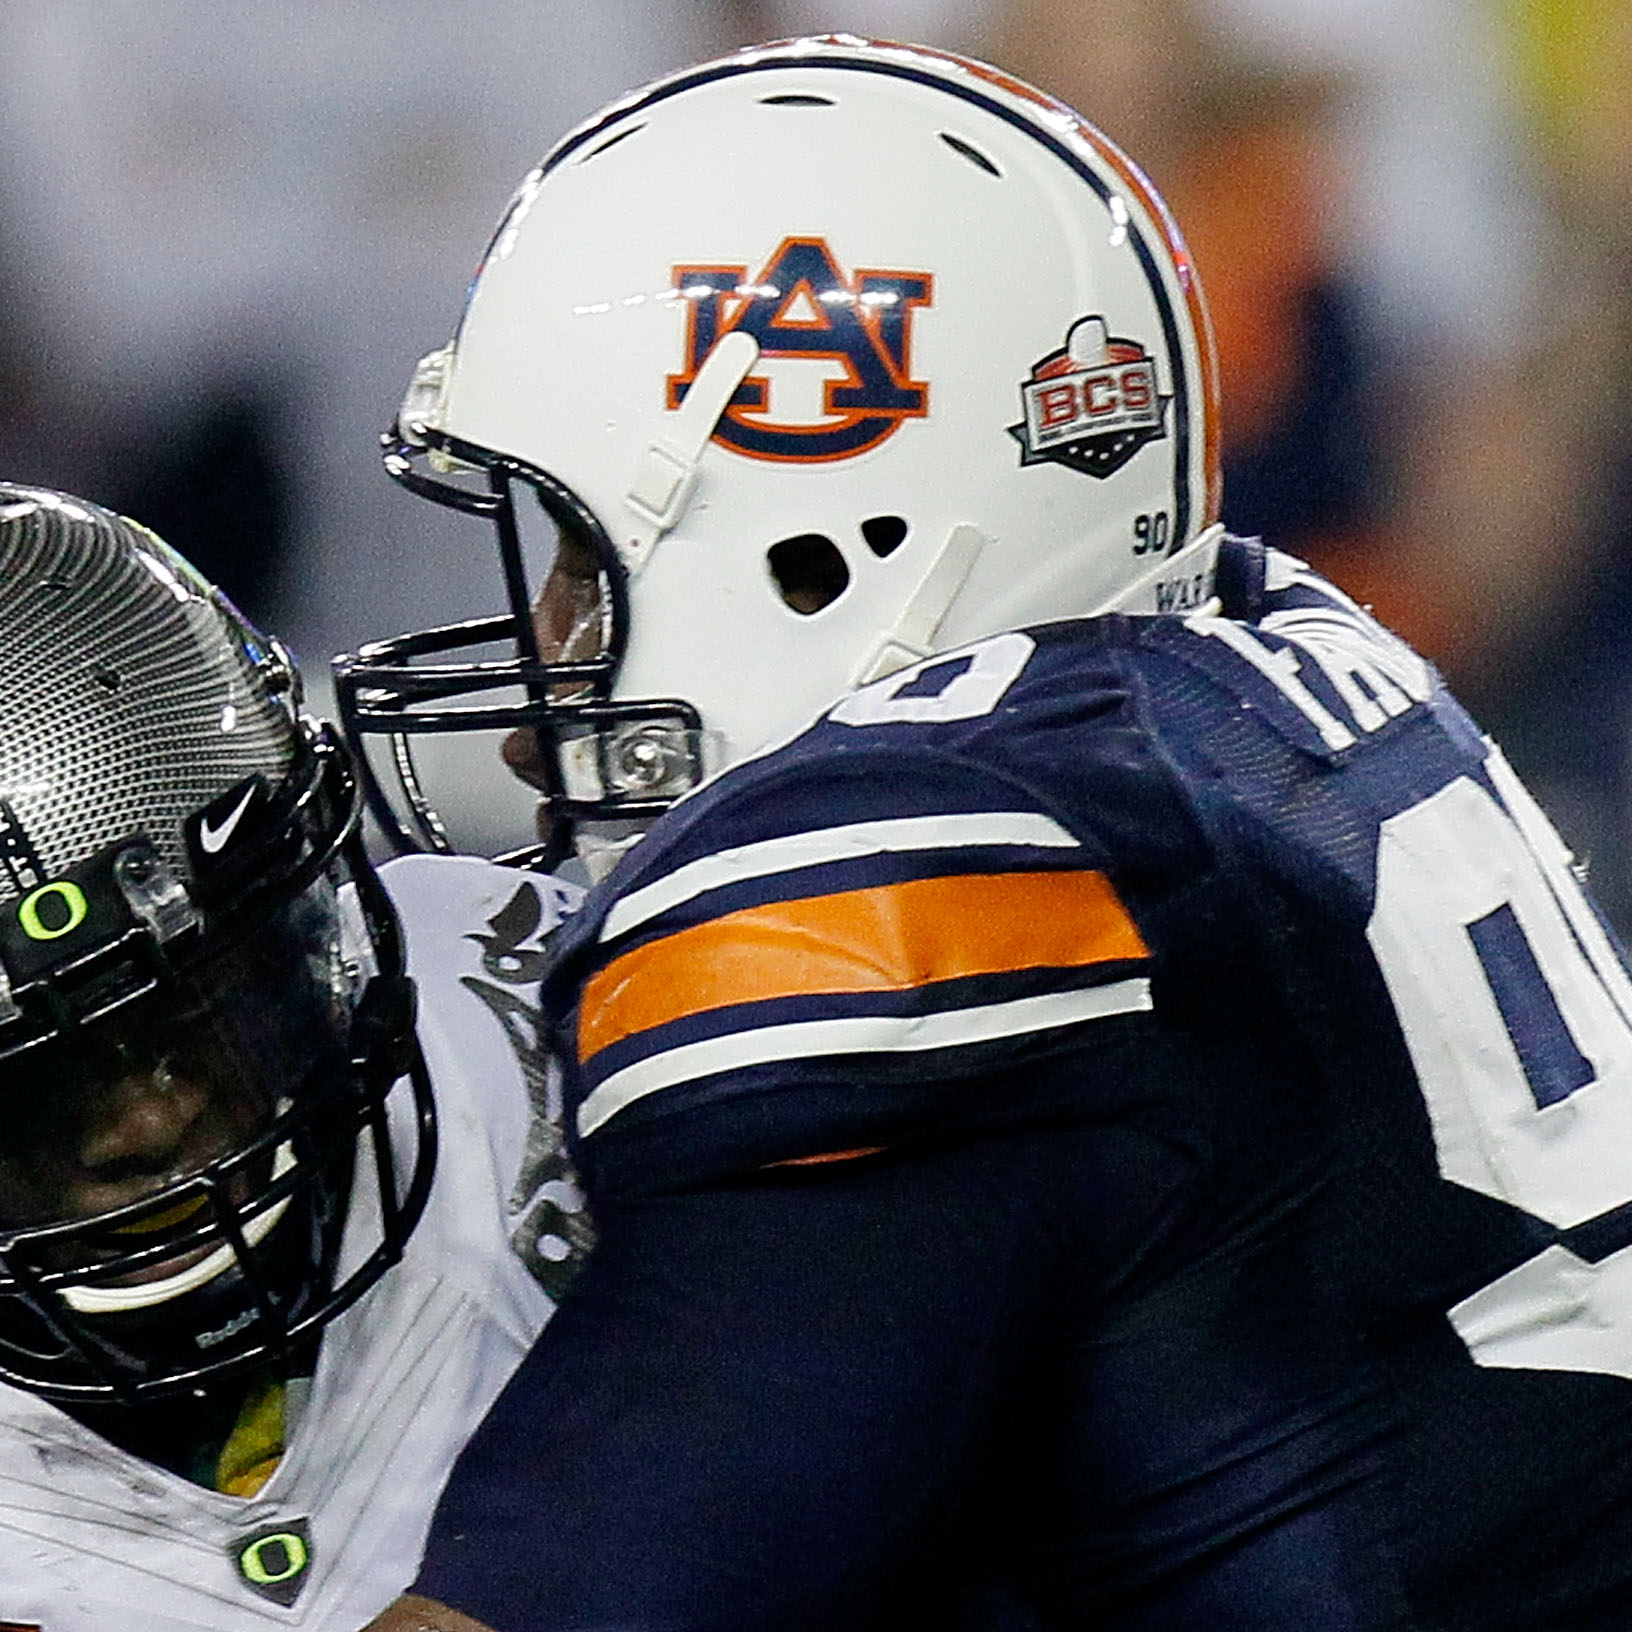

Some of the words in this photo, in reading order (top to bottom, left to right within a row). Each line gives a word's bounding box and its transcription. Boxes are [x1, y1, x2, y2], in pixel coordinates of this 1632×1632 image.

[1031, 370, 1151, 430] BCS
[1133, 511, 1168, 555] 90
[240, 1532, 307, 1585] O
